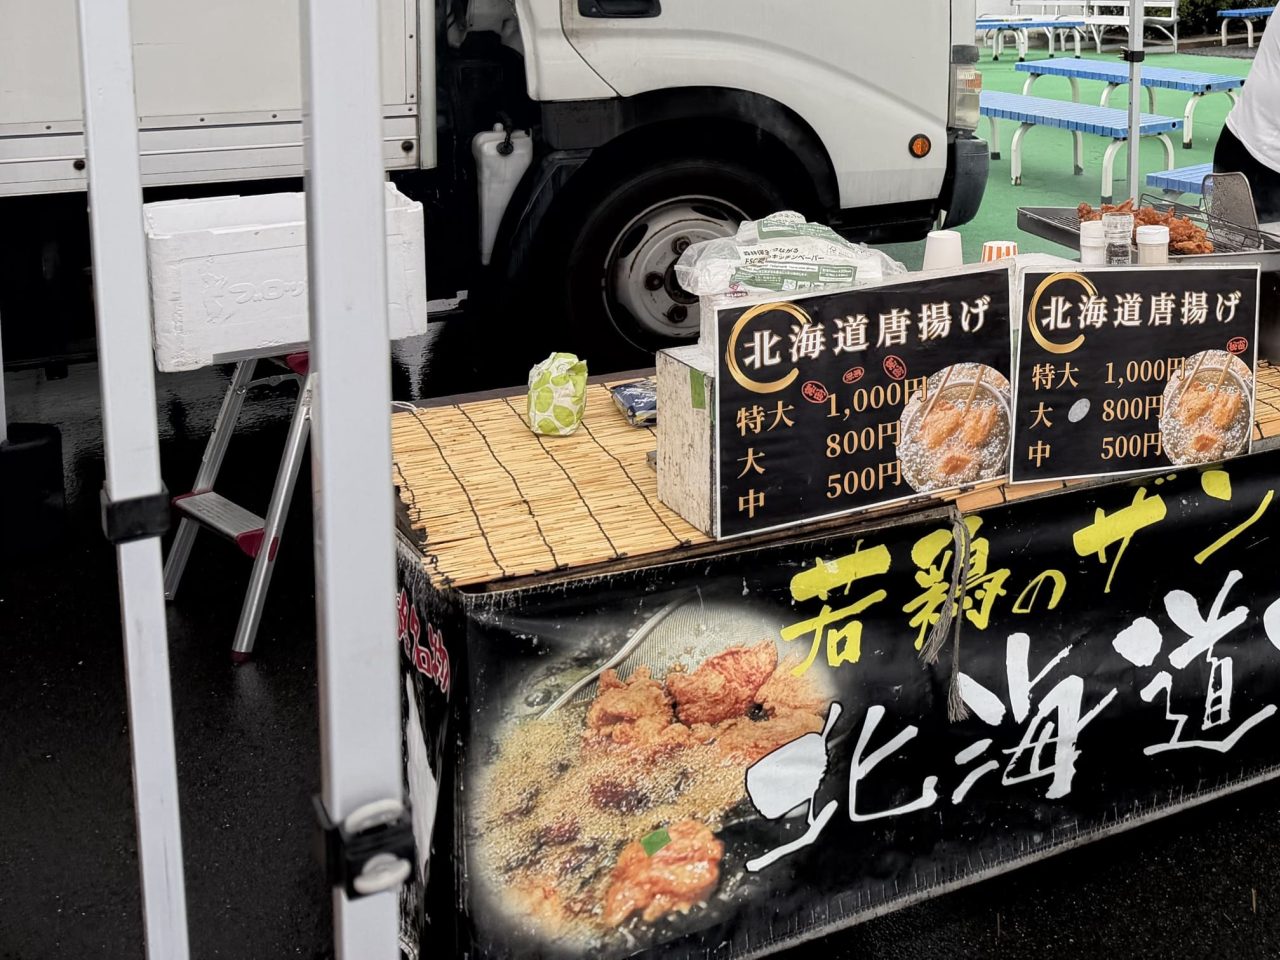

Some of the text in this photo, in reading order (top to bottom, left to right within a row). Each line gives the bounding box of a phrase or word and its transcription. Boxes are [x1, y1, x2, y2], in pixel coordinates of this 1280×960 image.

[743, 294, 992, 370] 北海道唐揚げ
[1041, 290, 1242, 331] 北海道唐揚げ
[1031, 356, 1186, 391] 特大 1,000円
[736, 375, 928, 437] 特大 1,000円
[1028, 394, 1164, 430] 大 800円
[737, 420, 903, 479] 大 800円
[1028, 431, 1163, 468] 中 500円
[738, 459, 903, 519] 中 500円
